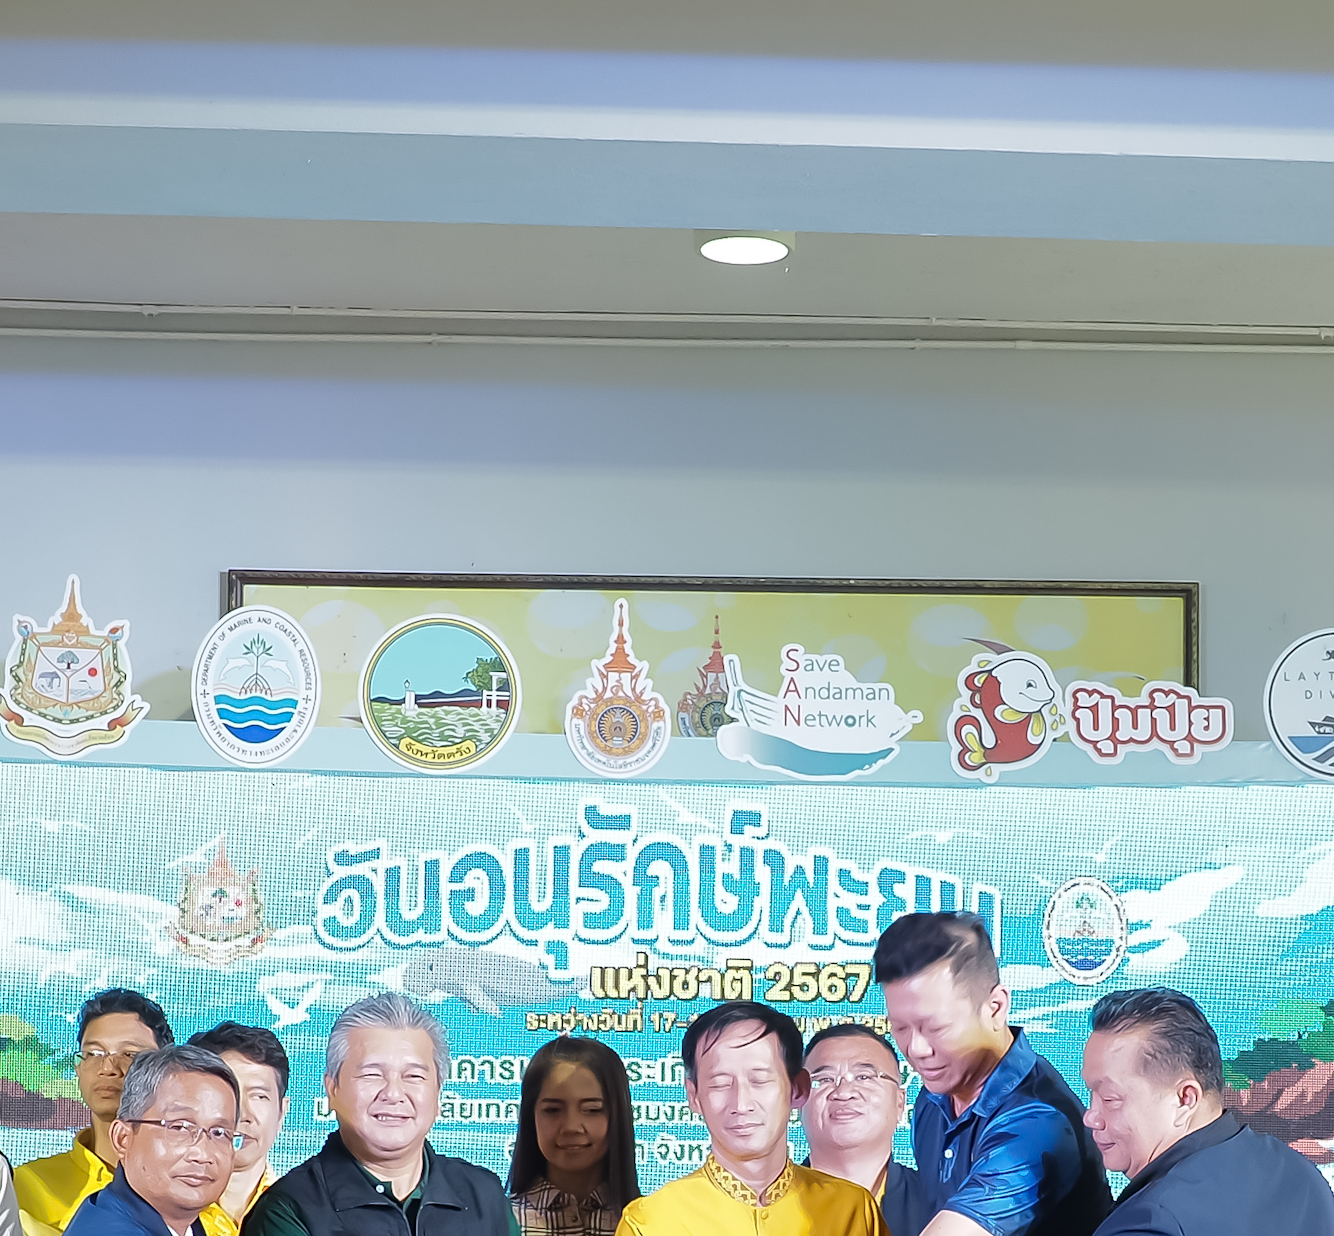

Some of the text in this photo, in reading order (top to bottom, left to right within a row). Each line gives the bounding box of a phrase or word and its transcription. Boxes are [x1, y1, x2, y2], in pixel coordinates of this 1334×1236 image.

[201, 642, 220, 686] DEPARTMENT
[227, 617, 254, 633] MARINE
[257, 616, 272, 625] AND
[274, 621, 299, 648] COASTAL
[297, 648, 313, 691] RESOURCES
[785, 648, 840, 673] Save
[783, 676, 890, 701] Andaman
[784, 704, 877, 728] Network
[1072, 688, 1225, 757] ปุ้มปุ้ย
[404, 741, 472, 760] จังหวัดตรัง
[322, 805, 996, 974] วันอนุรักษ์พะย
[589, 951, 873, 1002] แห่งชาติ 2567
